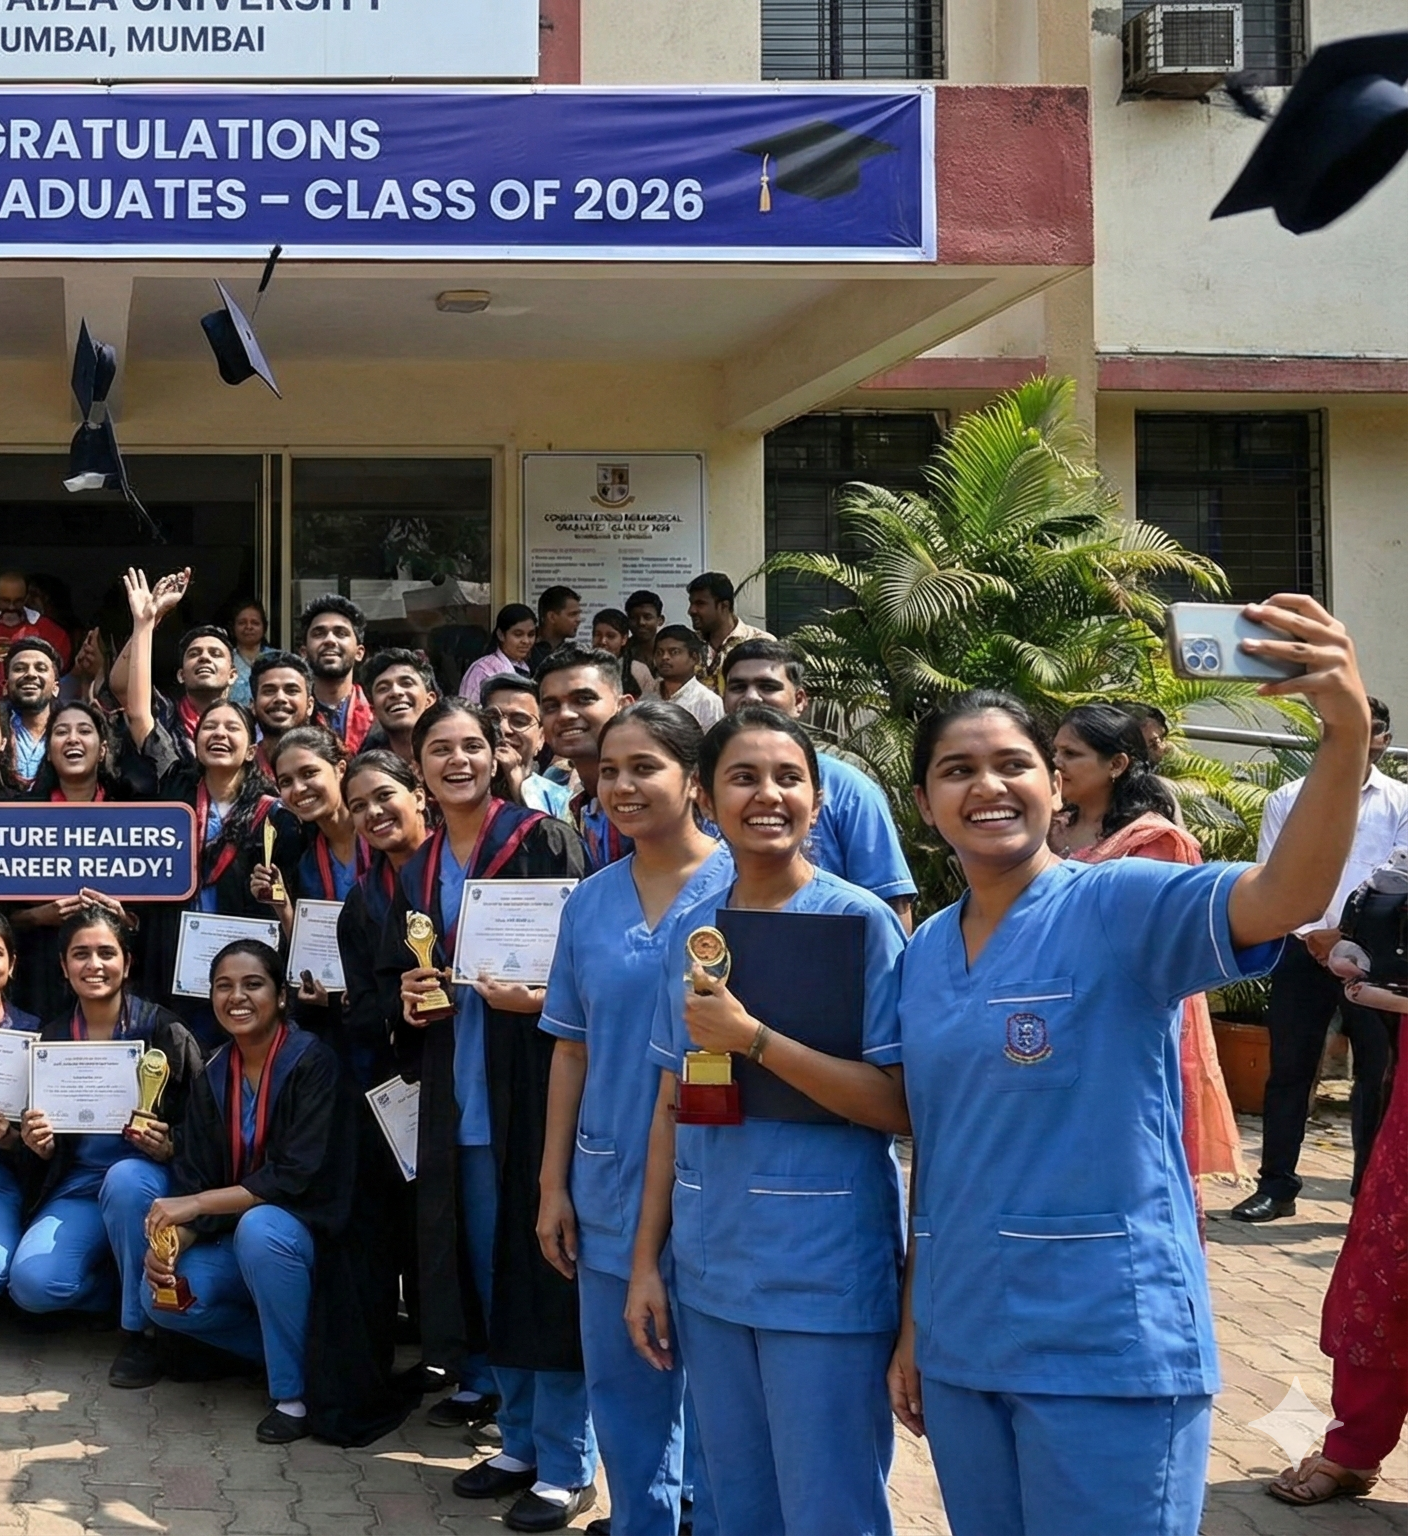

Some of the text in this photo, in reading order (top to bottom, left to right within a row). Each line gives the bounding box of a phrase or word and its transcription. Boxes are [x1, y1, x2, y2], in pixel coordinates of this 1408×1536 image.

[127, 26, 265, 52] MUMBAI
[304, 179, 476, 220] CLASS
[490, 179, 561, 220] OF
[574, 178, 704, 221] 2026
[64, 826, 183, 850] HEALERS,
[78, 857, 172, 878] READY!
